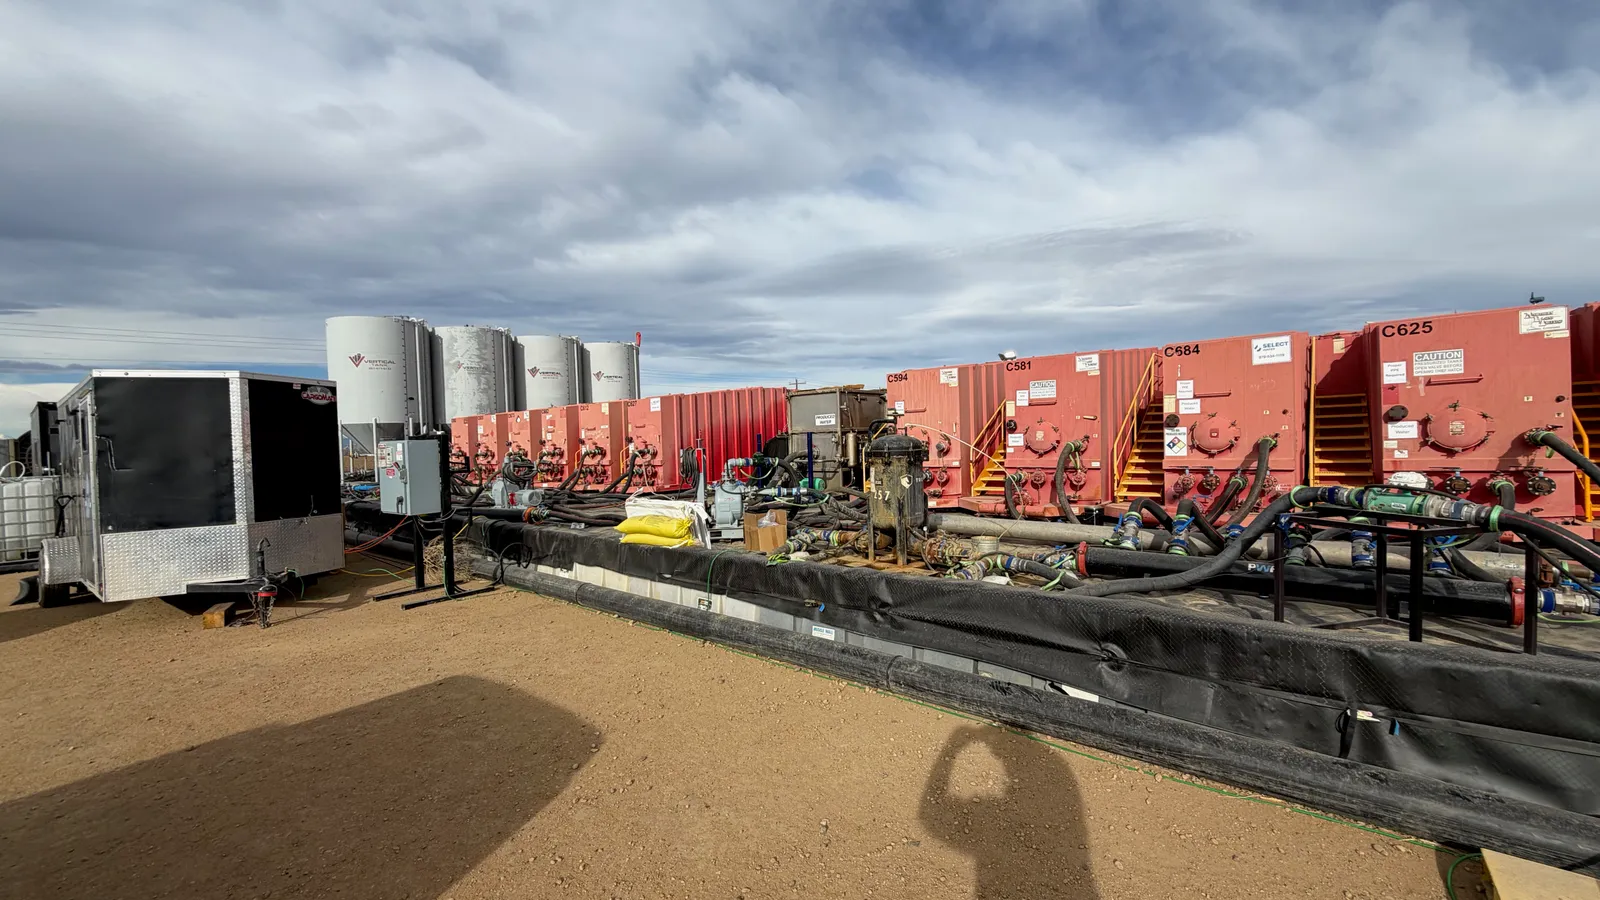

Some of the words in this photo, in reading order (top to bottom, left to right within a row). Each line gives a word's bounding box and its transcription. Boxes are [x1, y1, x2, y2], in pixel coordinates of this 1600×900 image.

[1382, 321, 1433, 338] C625
[1164, 344, 1200, 357] C684
[1415, 351, 1462, 361] CAUTION
[1006, 361, 1031, 371] C581
[887, 373, 908, 383] C594
